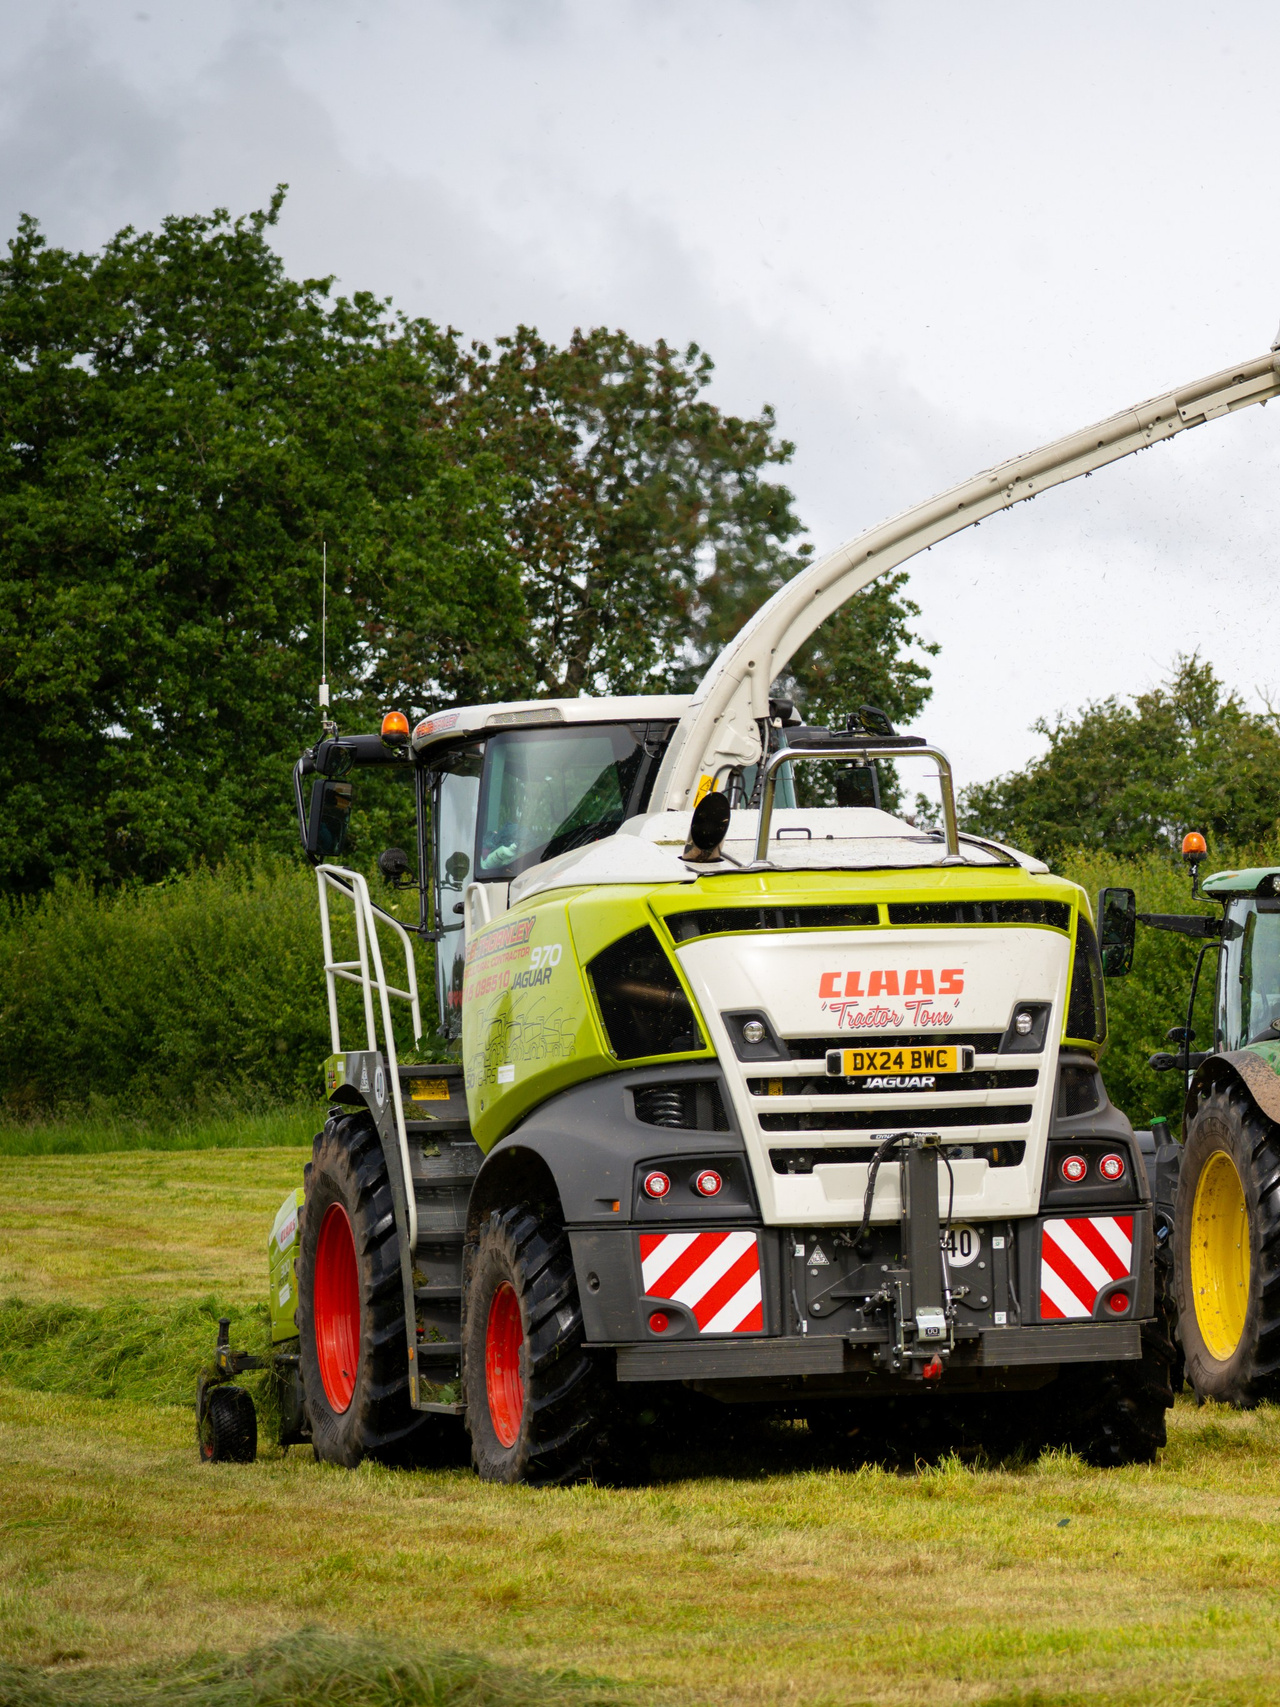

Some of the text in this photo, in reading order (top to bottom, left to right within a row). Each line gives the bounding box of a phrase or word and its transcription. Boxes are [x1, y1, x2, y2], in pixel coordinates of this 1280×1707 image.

[529, 943, 562, 970] 970
[511, 967, 552, 990] JAGUAR
[818, 969, 964, 999] CLAAS
[852, 1049, 948, 1072] DX24 BWC
[862, 1076, 936, 1089] JAGUAR
[941, 1229, 972, 1258] 40
